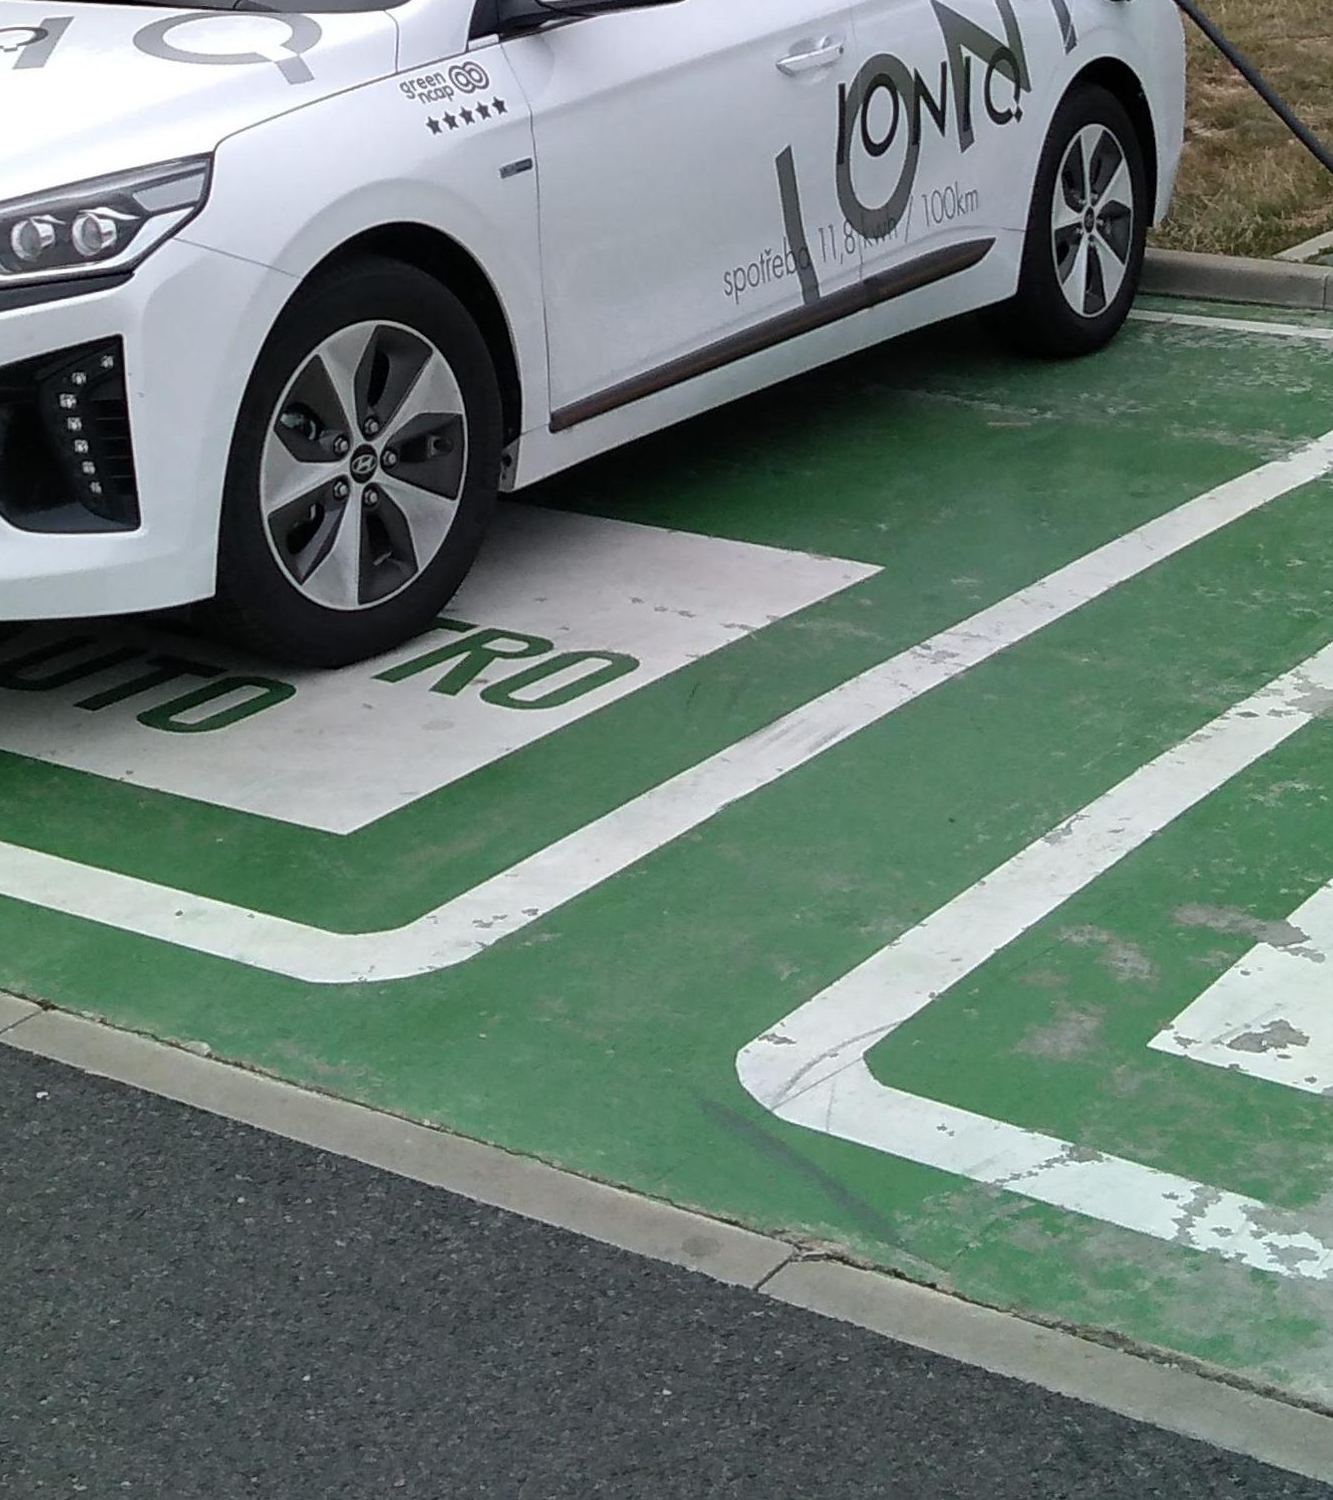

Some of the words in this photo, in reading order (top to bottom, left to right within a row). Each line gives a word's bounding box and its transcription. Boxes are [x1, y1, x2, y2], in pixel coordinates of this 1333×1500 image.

[399, 67, 447, 100] green
[418, 84, 455, 105] ncap
[836, 46, 1024, 166] IONIQ
[723, 236, 811, 305] spotřeba
[818, 219, 856, 265] 11,8
[921, 180, 980, 228] 100km
